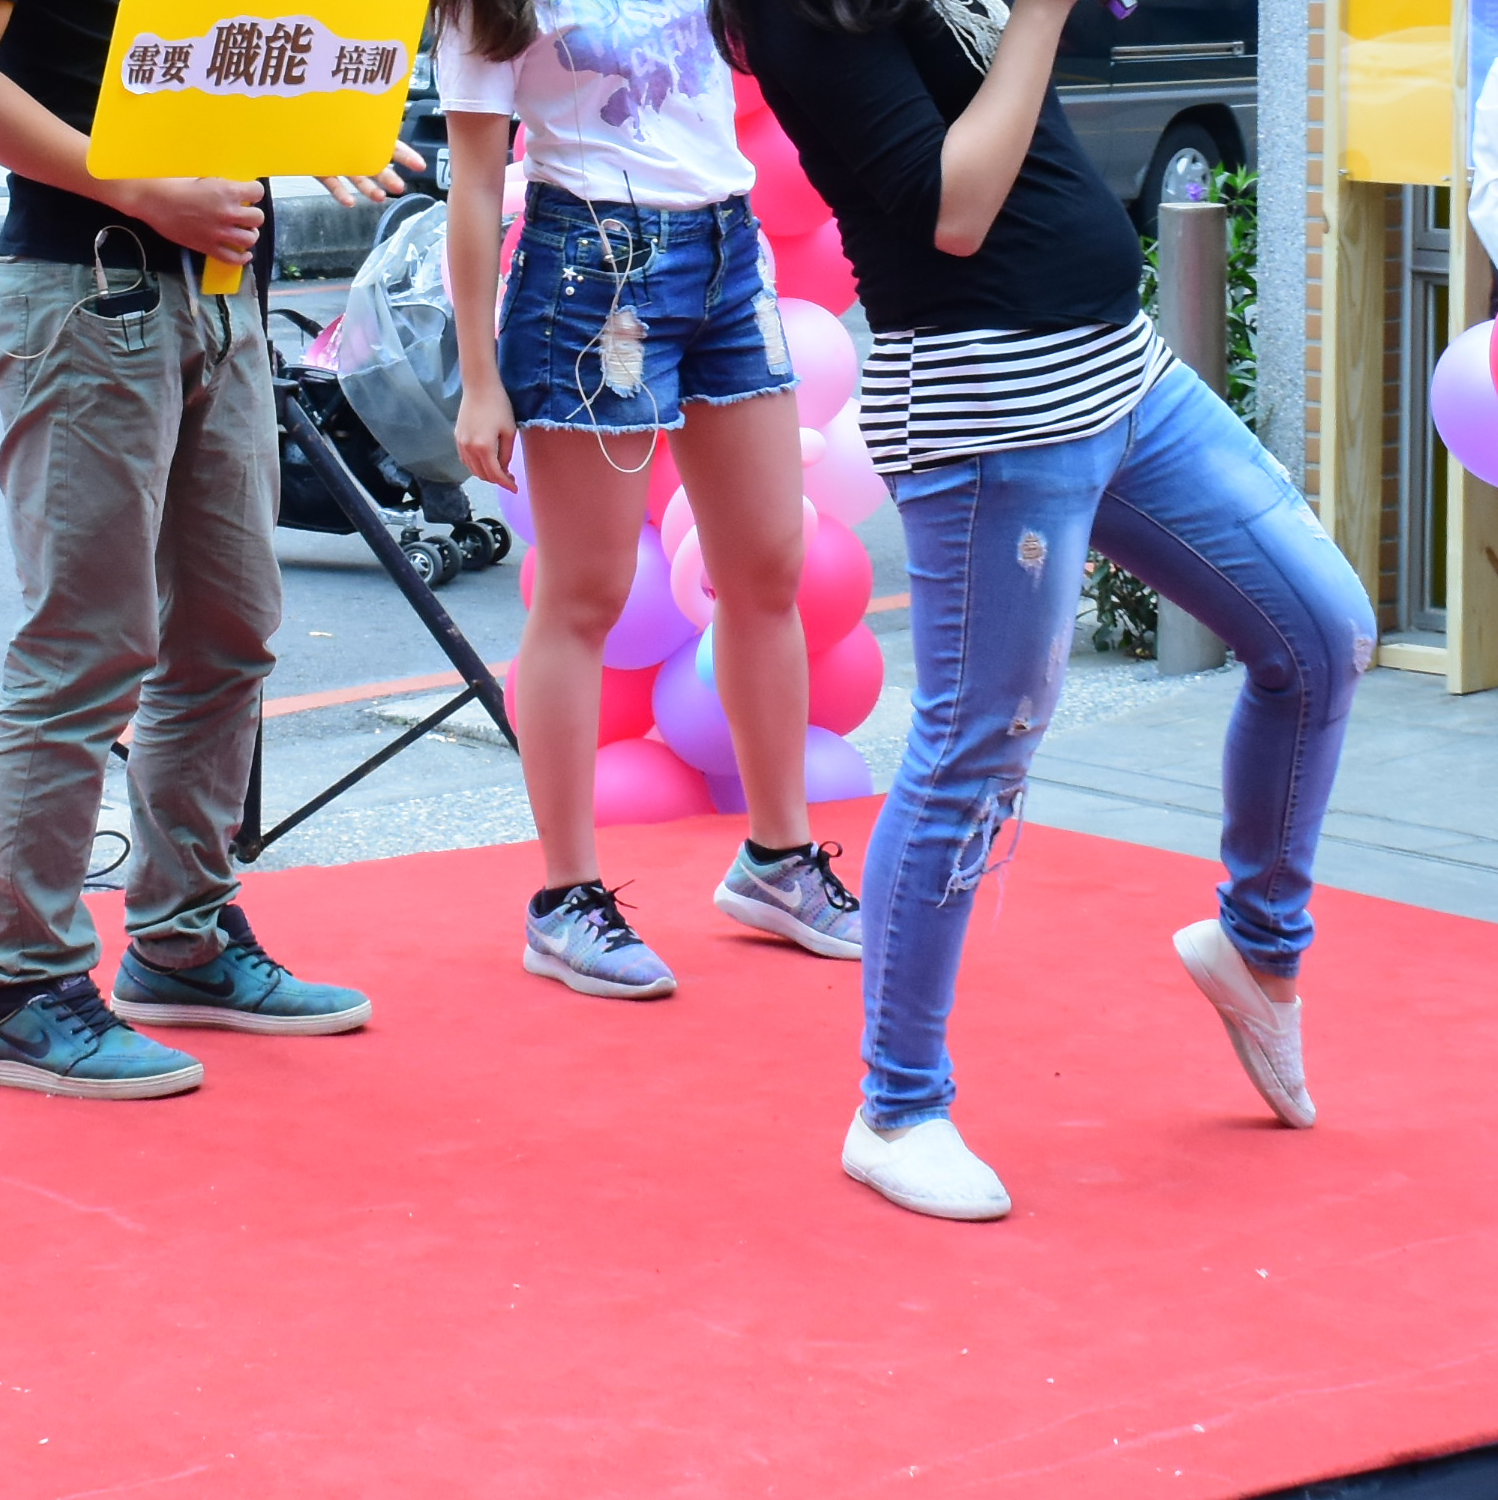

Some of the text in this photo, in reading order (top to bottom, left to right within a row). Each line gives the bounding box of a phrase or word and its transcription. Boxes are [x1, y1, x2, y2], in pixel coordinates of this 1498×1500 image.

[127, 22, 397, 86] 需要 職能 培訓
